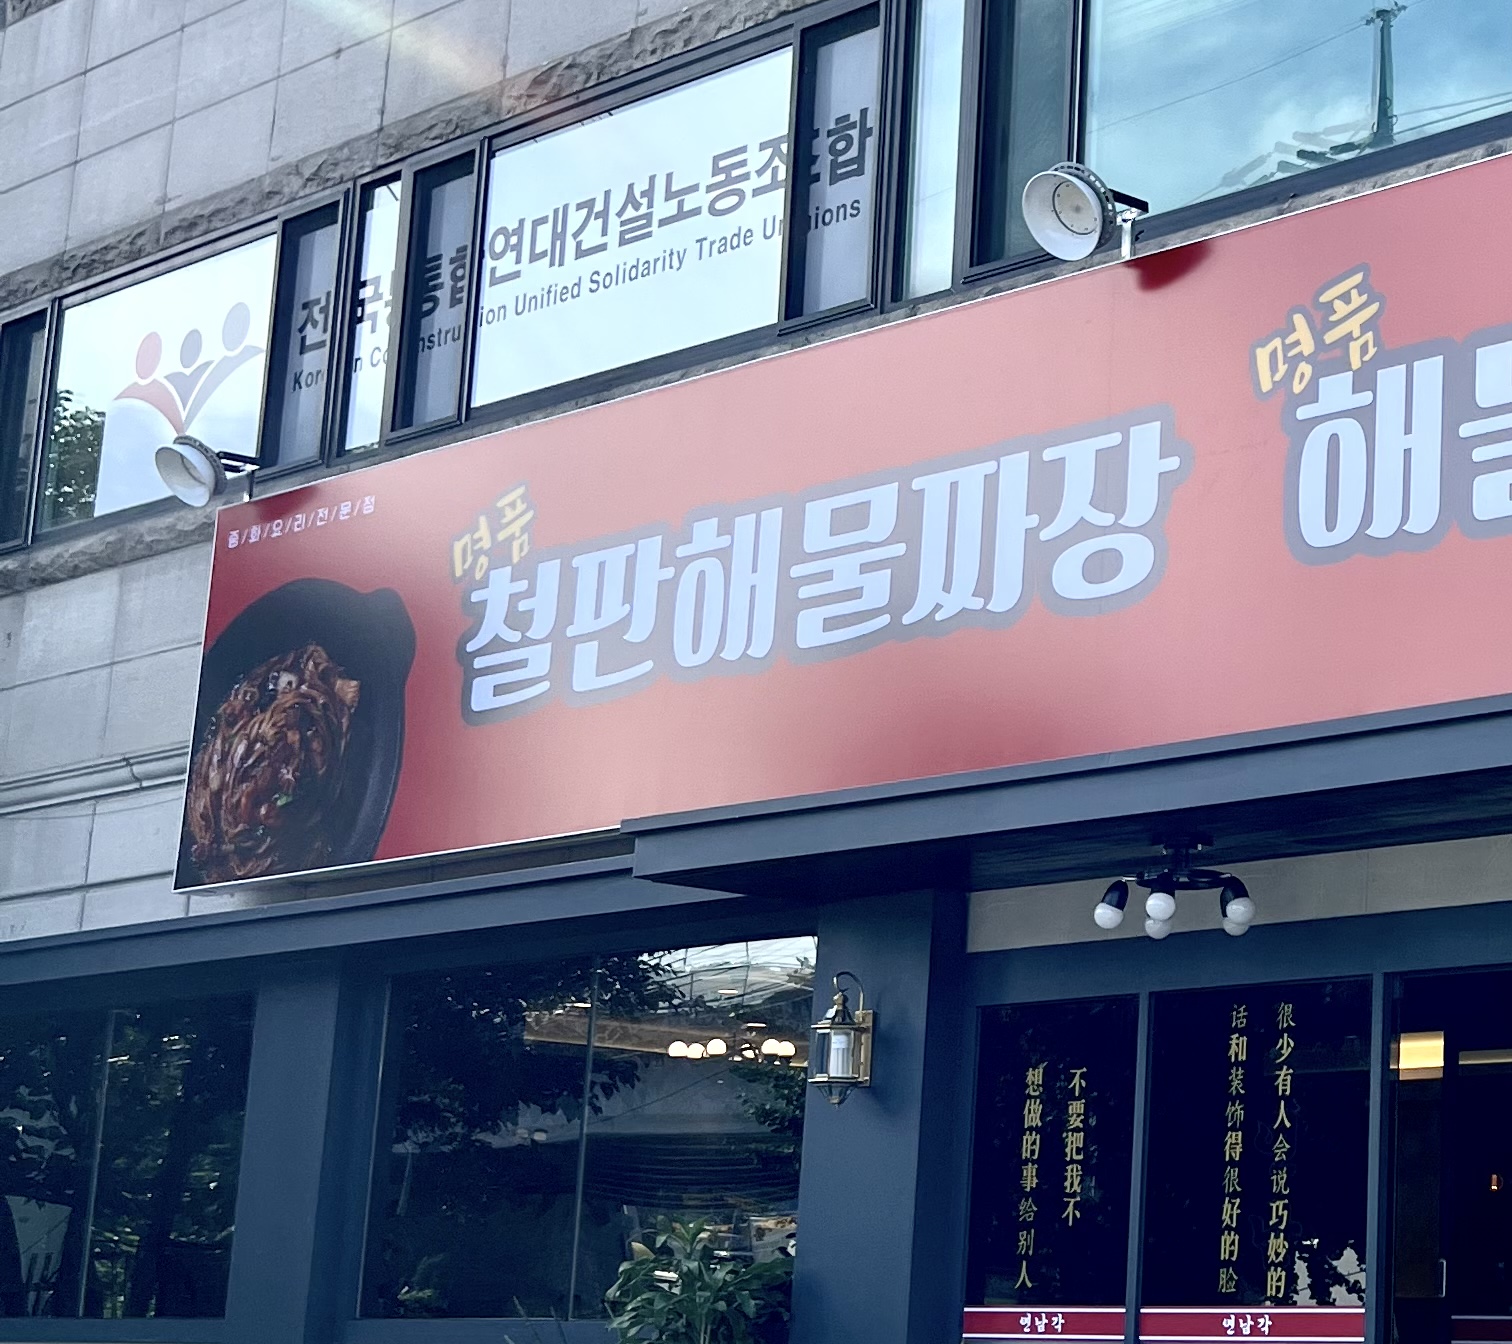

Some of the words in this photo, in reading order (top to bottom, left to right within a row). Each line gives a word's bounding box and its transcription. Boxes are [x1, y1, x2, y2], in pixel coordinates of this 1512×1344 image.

[515, 275, 581, 317] Unified
[589, 247, 687, 293] Solidarity
[695, 226, 753, 261] Trade
[1255, 272, 1380, 396] 명품
[454, 485, 534, 580] 명품
[467, 419, 1180, 713] 철판해물짜장
[1014, 1066, 1044, 1290] 想做的事给别人
[1061, 1067, 1087, 1227] 不要把我不
[1218, 1003, 1248, 1293] 话和装饰得很好的脸
[1267, 1002, 1296, 1297] 很少有人会说巧妙的
[1019, 1312, 1065, 1333] 연남각
[1222, 1314, 1272, 1336] 연남각
